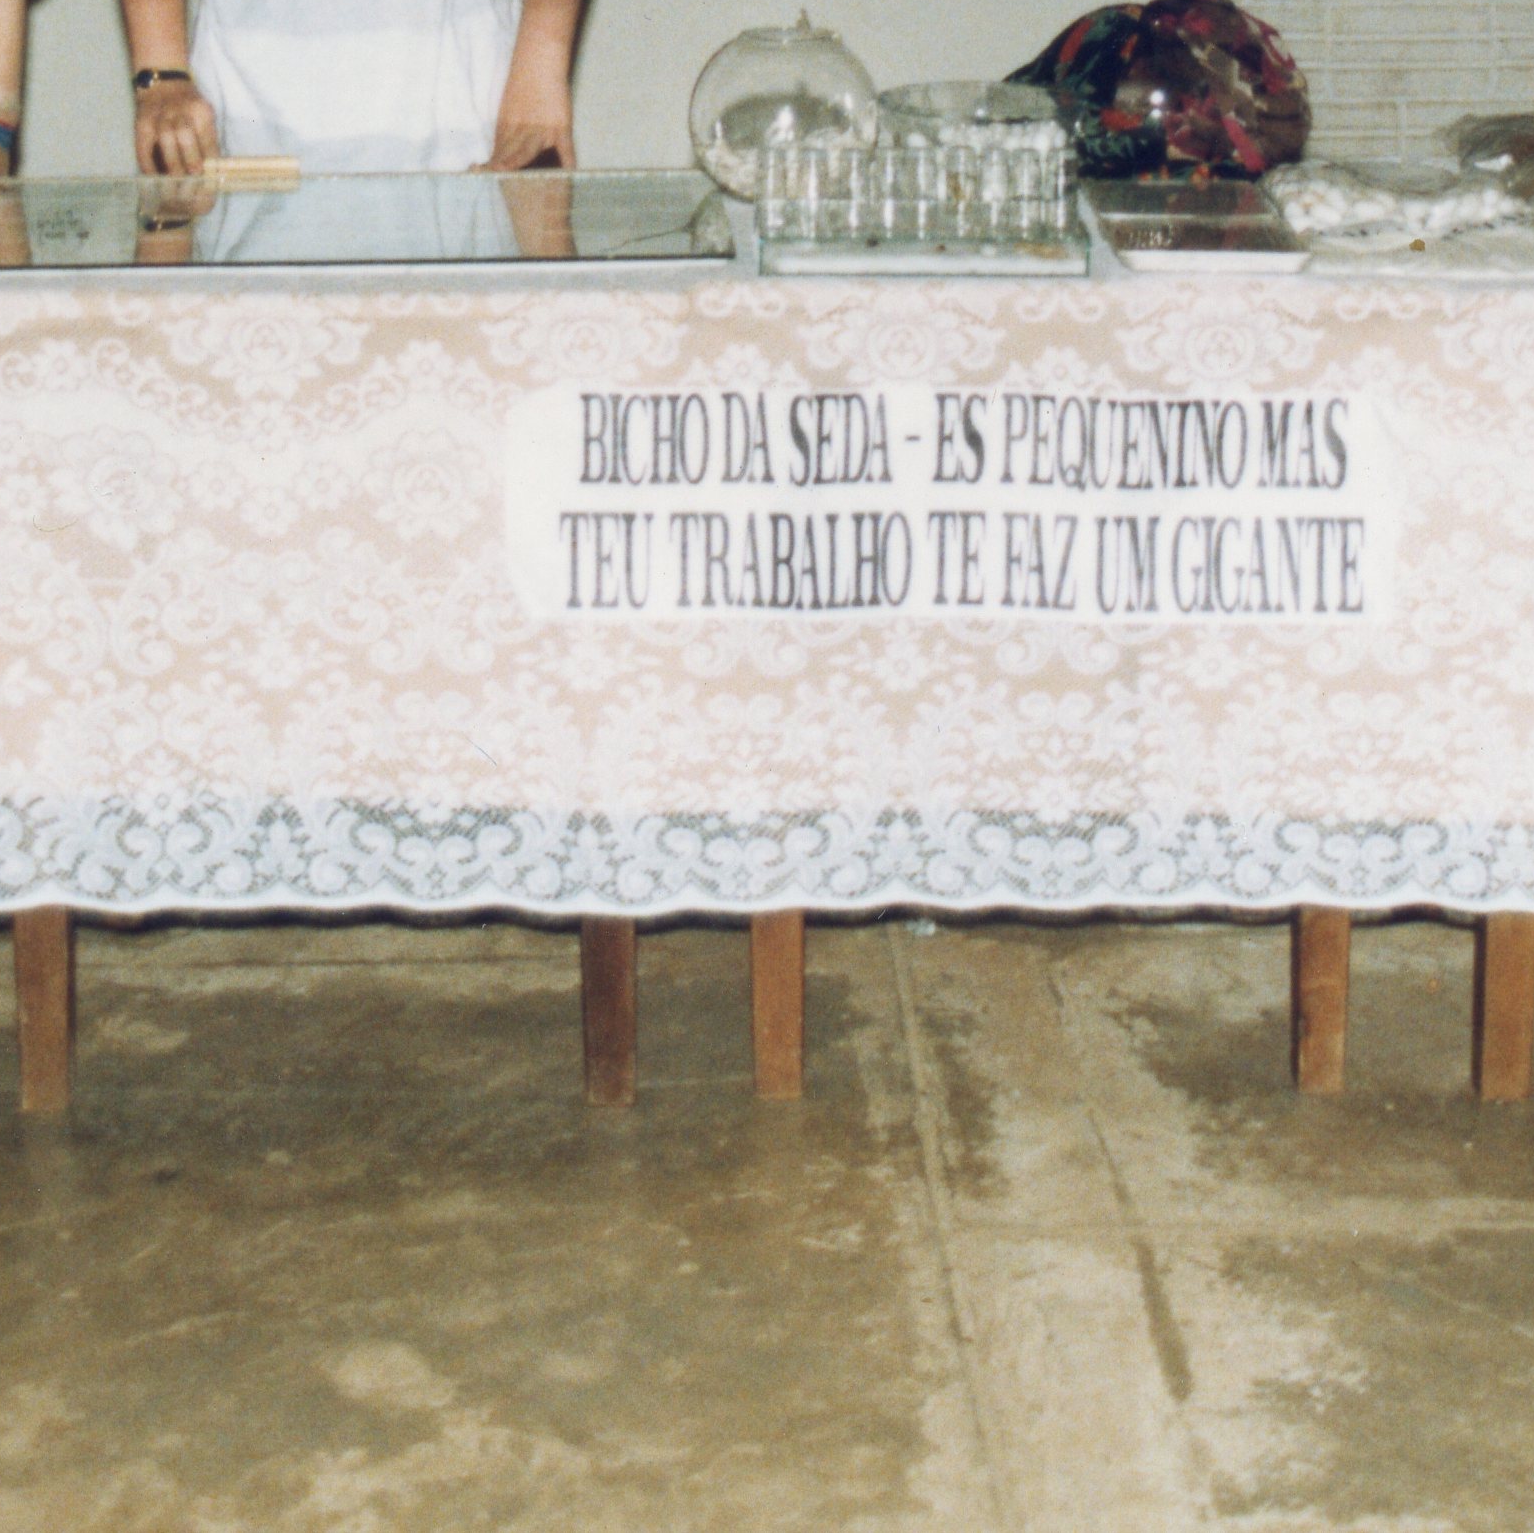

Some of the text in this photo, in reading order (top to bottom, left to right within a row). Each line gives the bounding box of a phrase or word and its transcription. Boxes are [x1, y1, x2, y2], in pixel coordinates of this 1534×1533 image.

[579, 392, 710, 487] BICHO
[720, 392, 775, 485] DA
[788, 392, 894, 487] SEDA
[932, 392, 988, 487] ES
[999, 393, 1249, 493] PEQUENINO
[1256, 397, 1350, 489] MAS
[559, 510, 1367, 615] TEU TRABALHO TE FAZ UM GIGANTE
